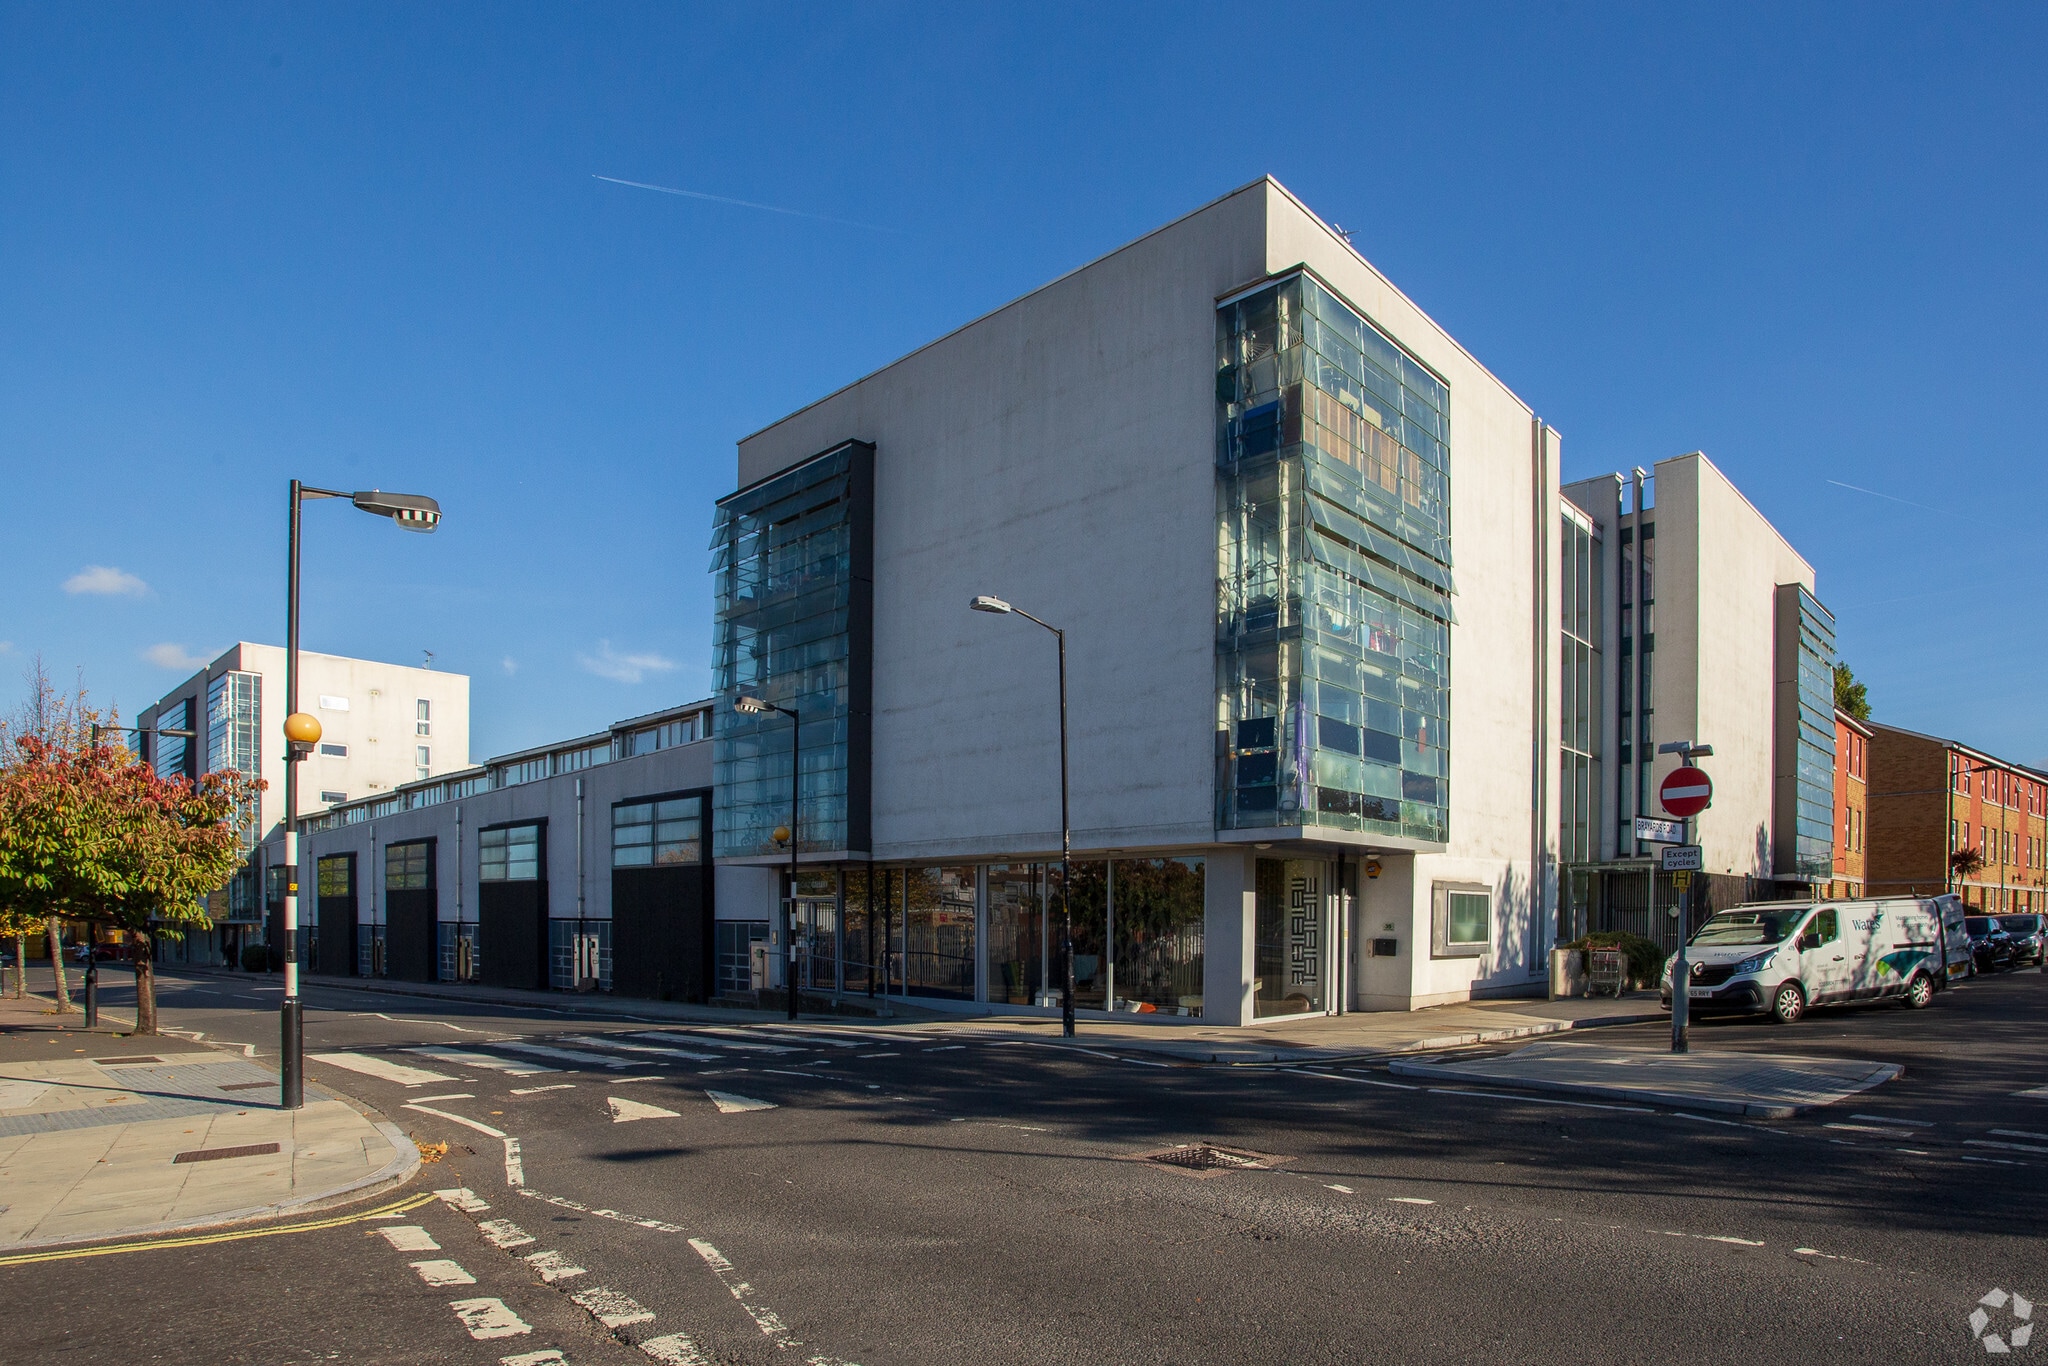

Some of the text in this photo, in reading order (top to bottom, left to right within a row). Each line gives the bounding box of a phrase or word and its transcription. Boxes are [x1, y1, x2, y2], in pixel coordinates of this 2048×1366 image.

[1637, 820, 1662, 832] BRAYARDS
[1666, 850, 1697, 858] Except
[1667, 859, 1696, 867] cycles
[1852, 919, 1881, 931] Wates
